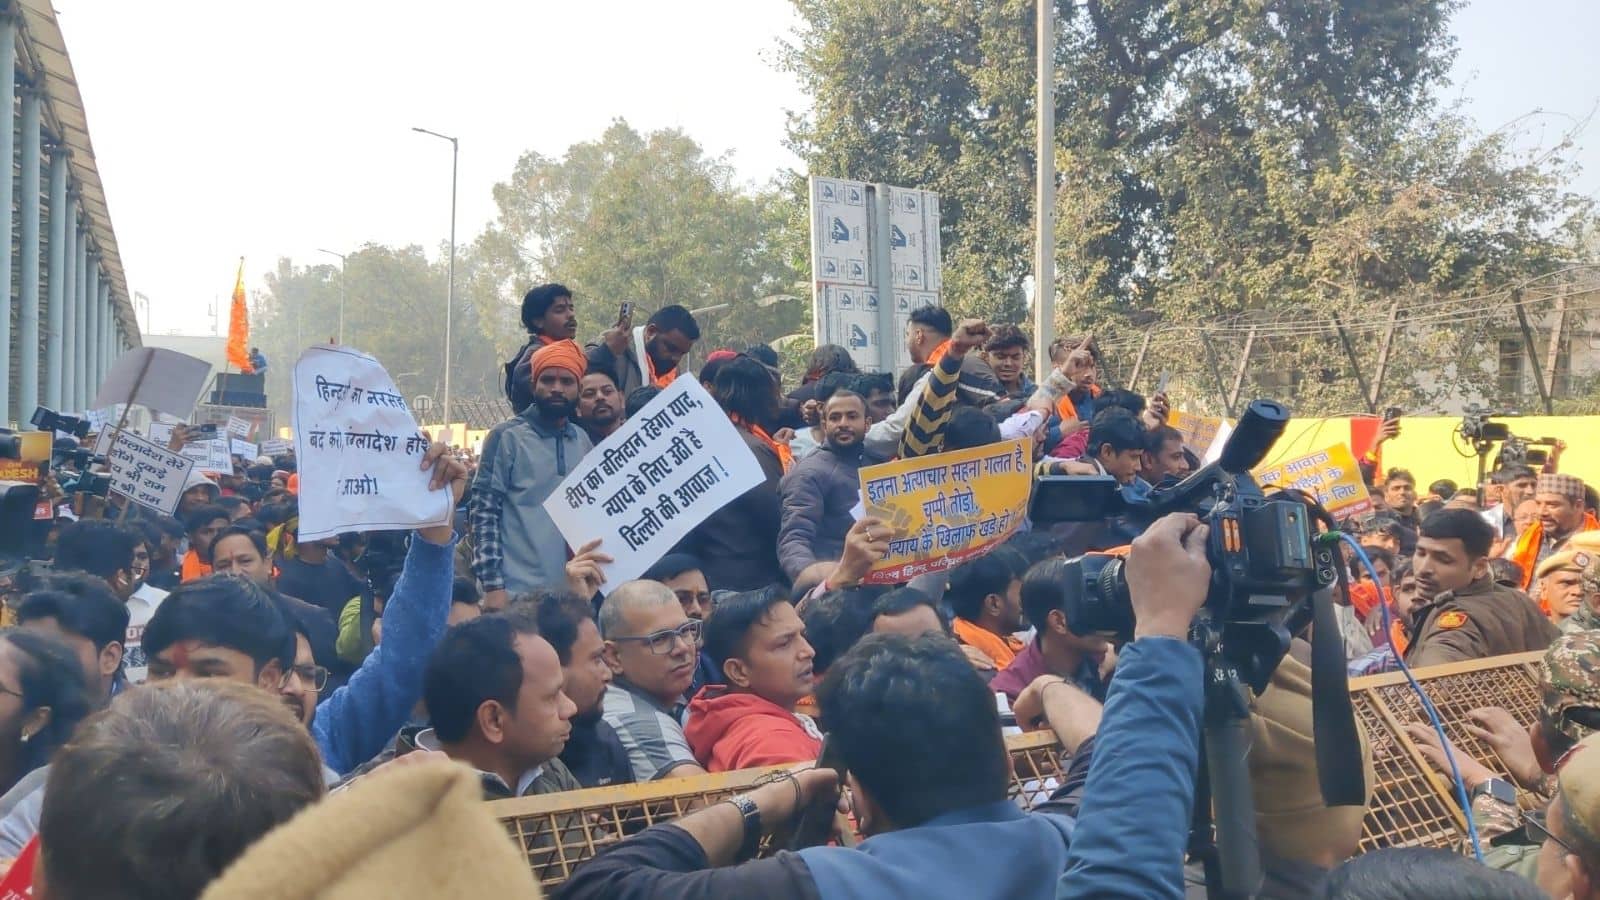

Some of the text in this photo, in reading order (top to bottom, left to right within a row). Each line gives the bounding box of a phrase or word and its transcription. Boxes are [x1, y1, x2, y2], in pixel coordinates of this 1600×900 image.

[367, 388, 407, 412] नरसंह
[308, 424, 326, 450] बंद
[565, 391, 704, 510] दीपू का बलिदान रहेगा याद,
[601, 427, 704, 517] न्याय के लिए उठी है
[866, 475, 898, 503] इतना
[901, 465, 948, 493] अत्याचार
[951, 459, 981, 483] सहना
[984, 452, 1012, 475] गलत
[618, 507, 665, 551] दिल्ली
[659, 493, 680, 521] की
[922, 491, 947, 527] चुप्पी
[921, 526, 934, 551] के
[935, 525, 977, 550] खिलाफ
